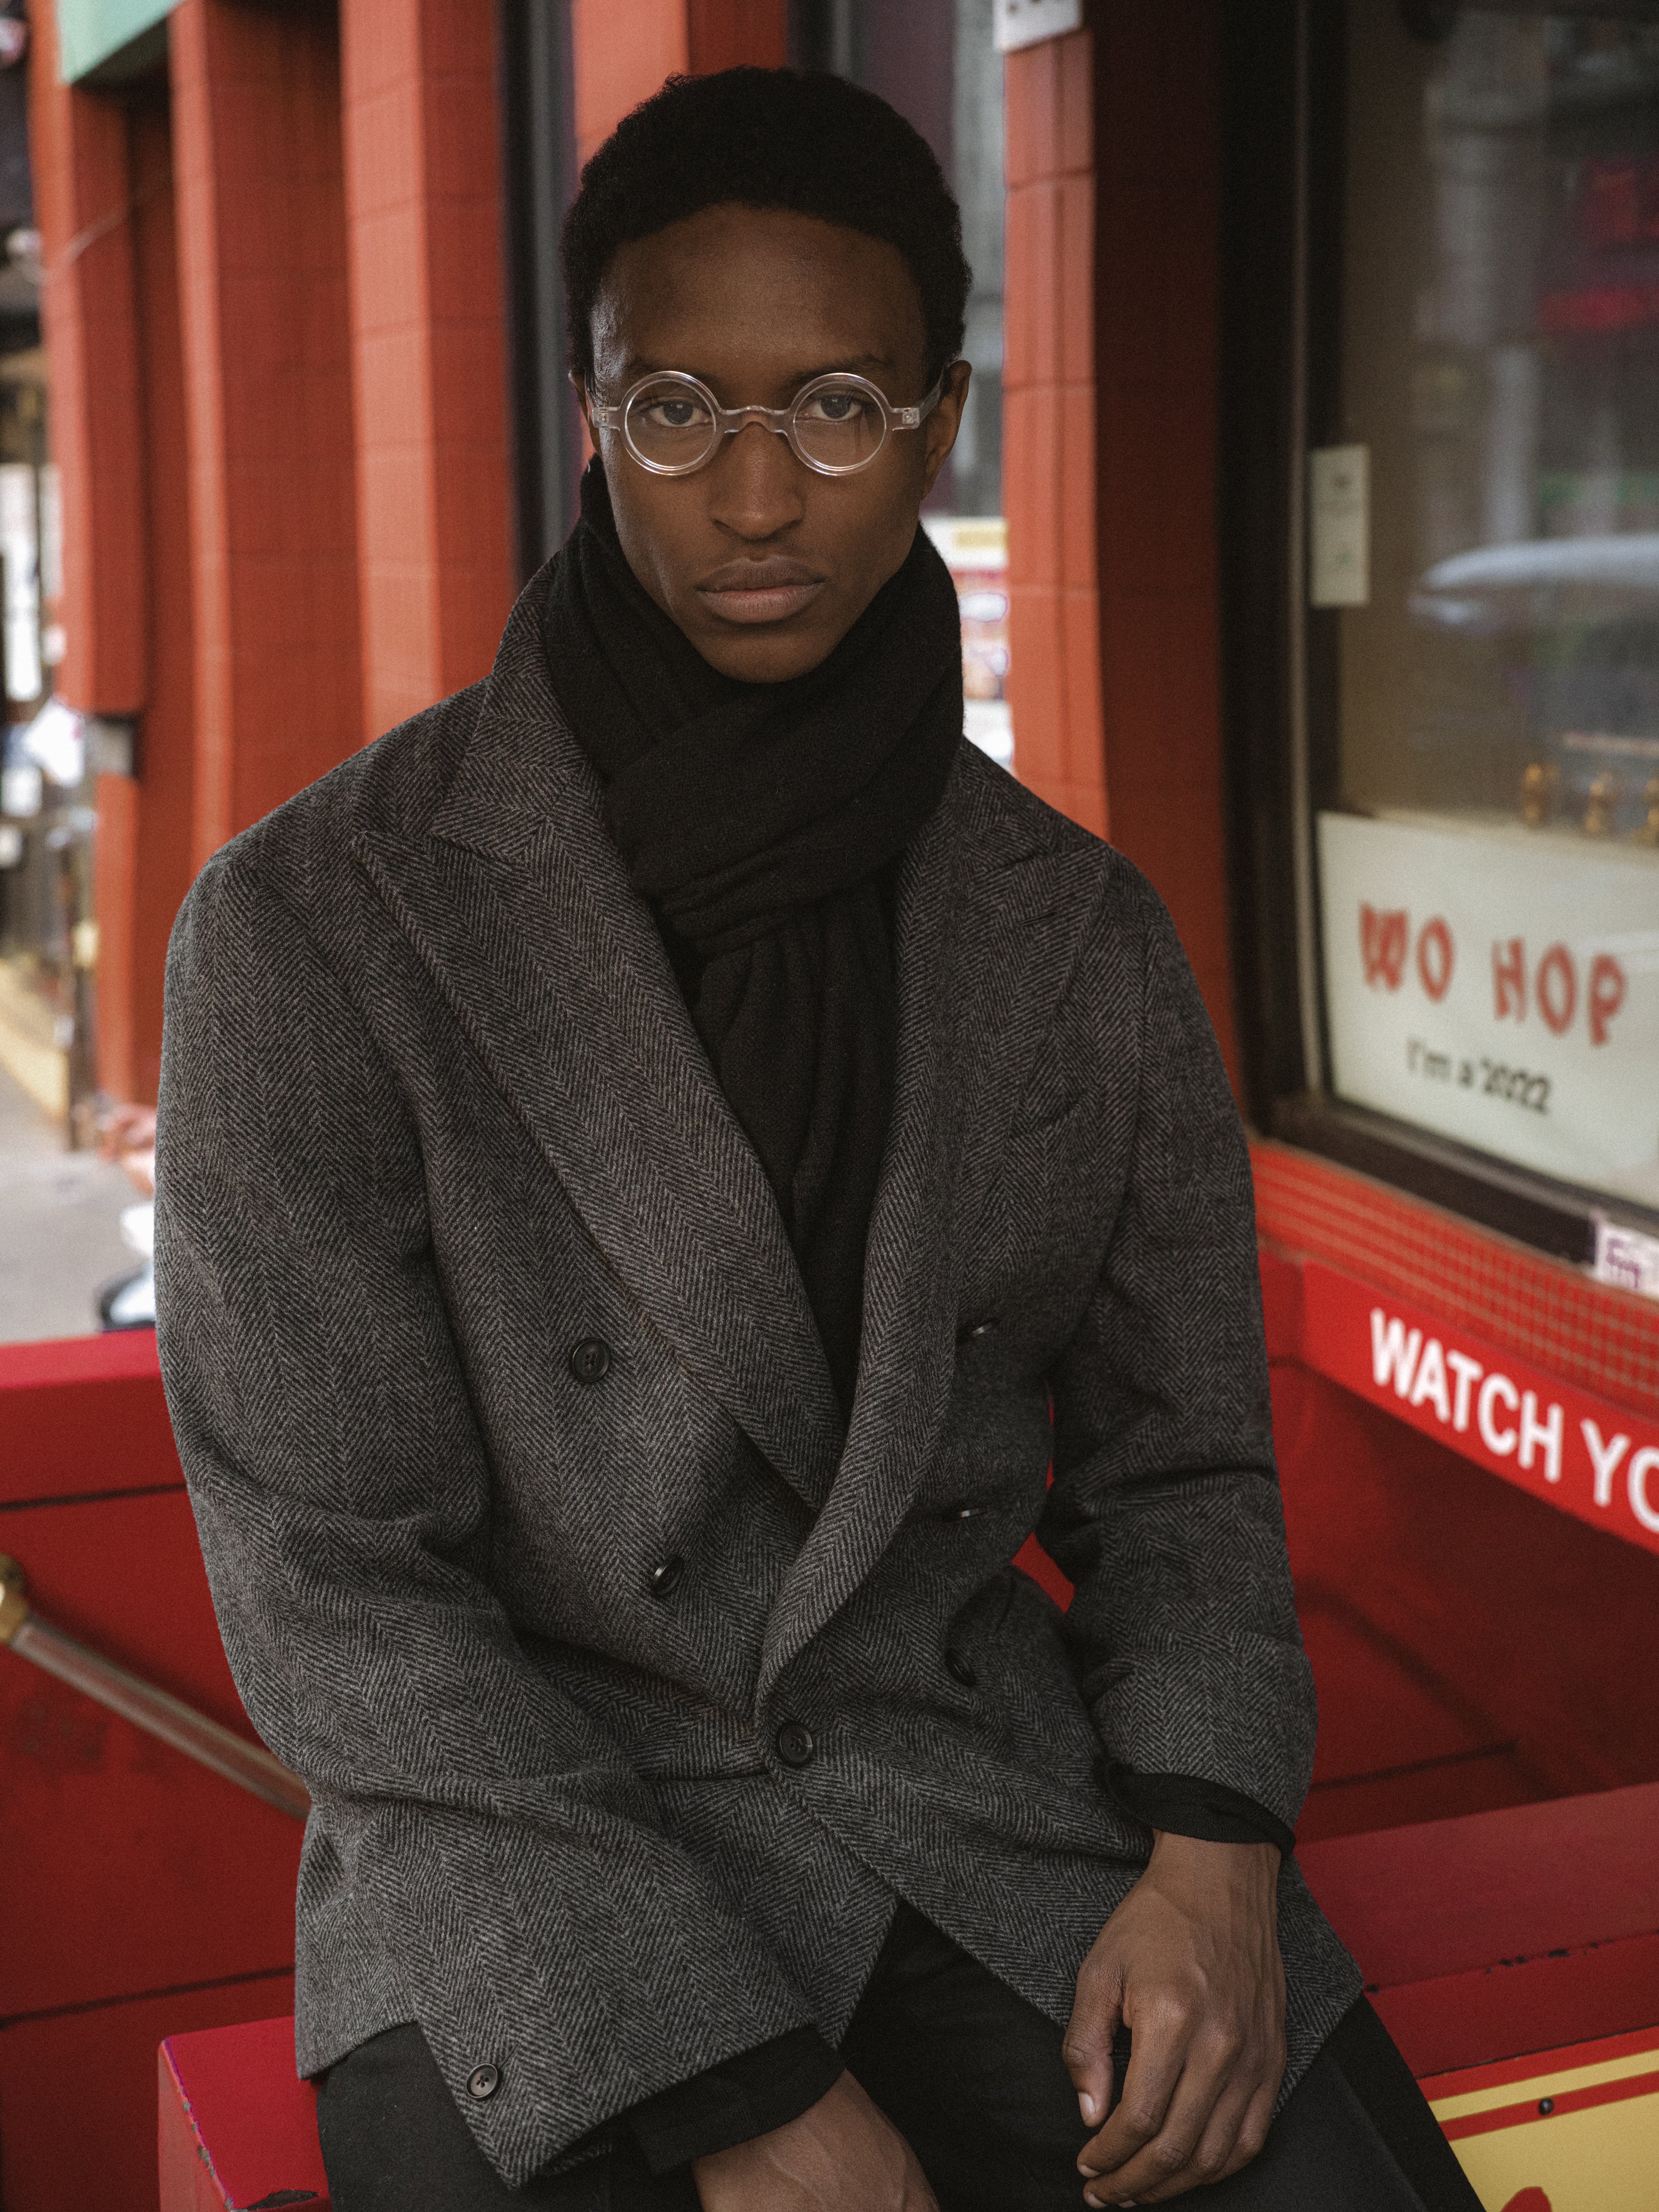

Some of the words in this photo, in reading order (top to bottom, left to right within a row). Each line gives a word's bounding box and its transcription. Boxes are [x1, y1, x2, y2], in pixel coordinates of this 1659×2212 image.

[1358, 901, 1455, 1003] WO
[1491, 936, 1627, 1047] HOP
[1370, 1307, 1565, 1483] WATCH
